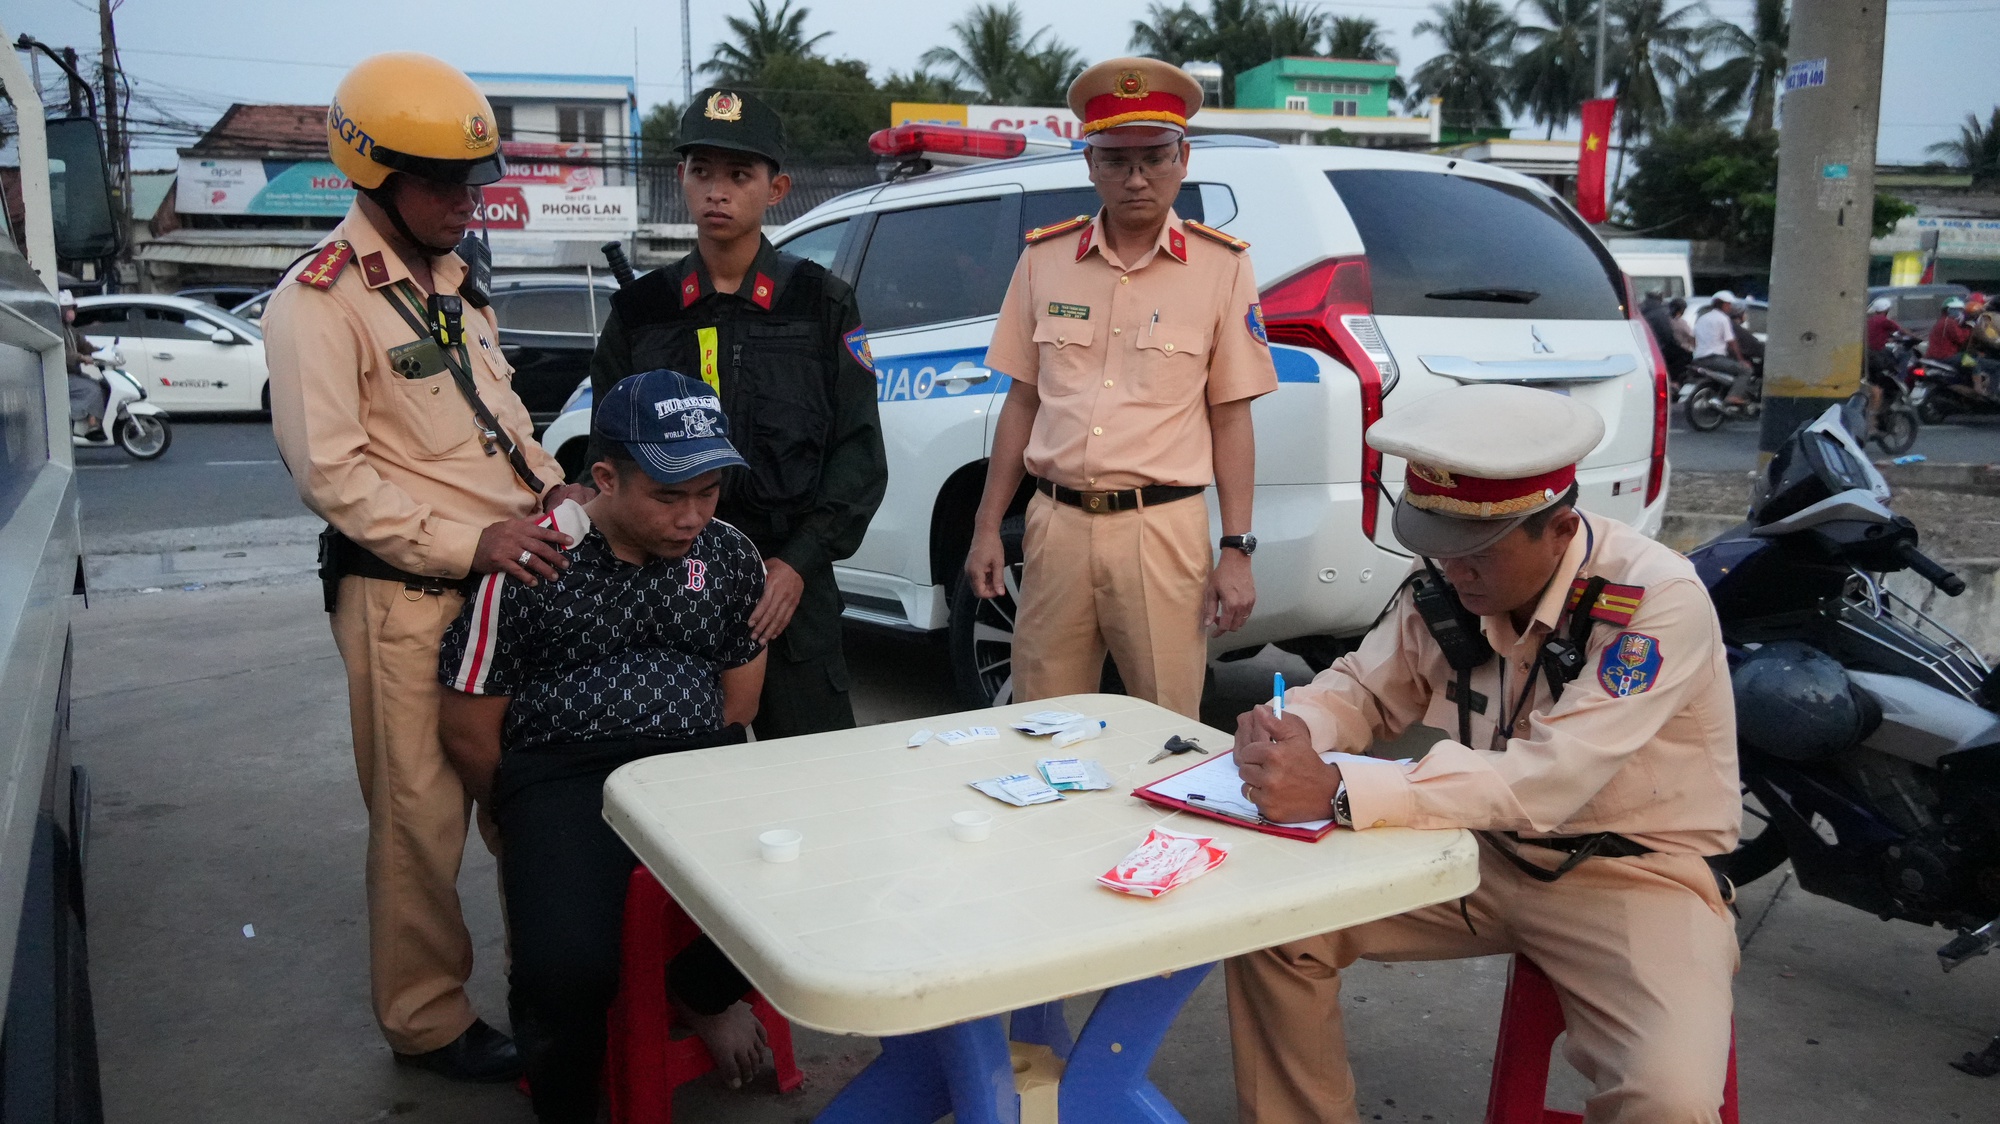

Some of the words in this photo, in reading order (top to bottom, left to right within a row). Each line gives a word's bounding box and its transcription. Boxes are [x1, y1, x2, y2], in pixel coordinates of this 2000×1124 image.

[331, 97, 376, 157] SGT
[542, 204, 591, 215] PHONG
[594, 204, 621, 214] LAN
[654, 398, 684, 420] TRUE
[663, 430, 685, 440] WORLD
[685, 558, 706, 592] B
[1606, 665, 1625, 677] CS
[1631, 669, 1647, 682] GT
